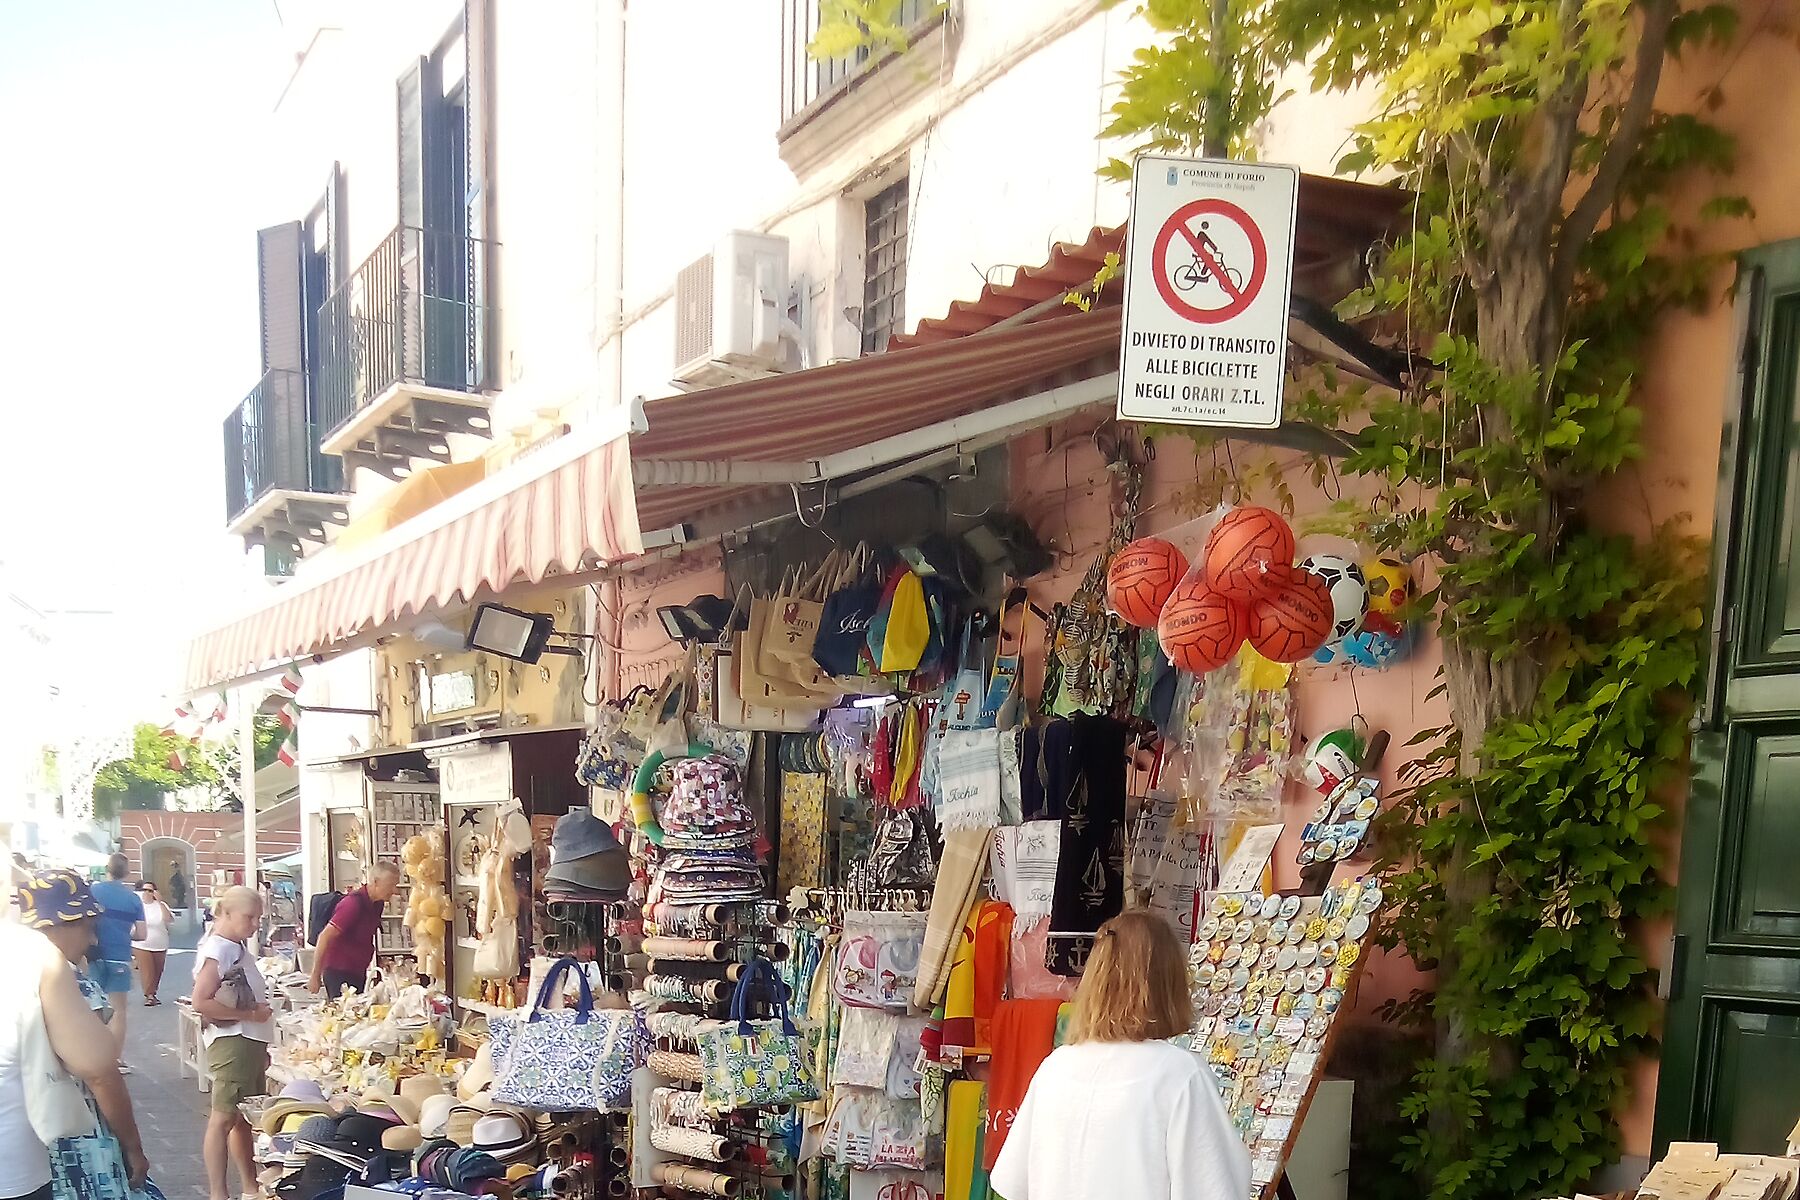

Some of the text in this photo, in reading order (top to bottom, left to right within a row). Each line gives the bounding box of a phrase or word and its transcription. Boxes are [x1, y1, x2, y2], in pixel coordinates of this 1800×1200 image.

[1183, 168, 1222, 179] COMUNE
[1236, 173, 1265, 182] FORIO
[1132, 331, 1276, 355] DIVIETO DI TRANSITO
[1145, 358, 1258, 379] ALLE BICICLETTE
[1135, 383, 1265, 405] NEGLI ORARI Z.T.L.
[1166, 612, 1208, 630] MONDO
[946, 785, 979, 803] Ischia
[994, 830, 1006, 868] Ischia
[881, 1144, 893, 1153] LA
